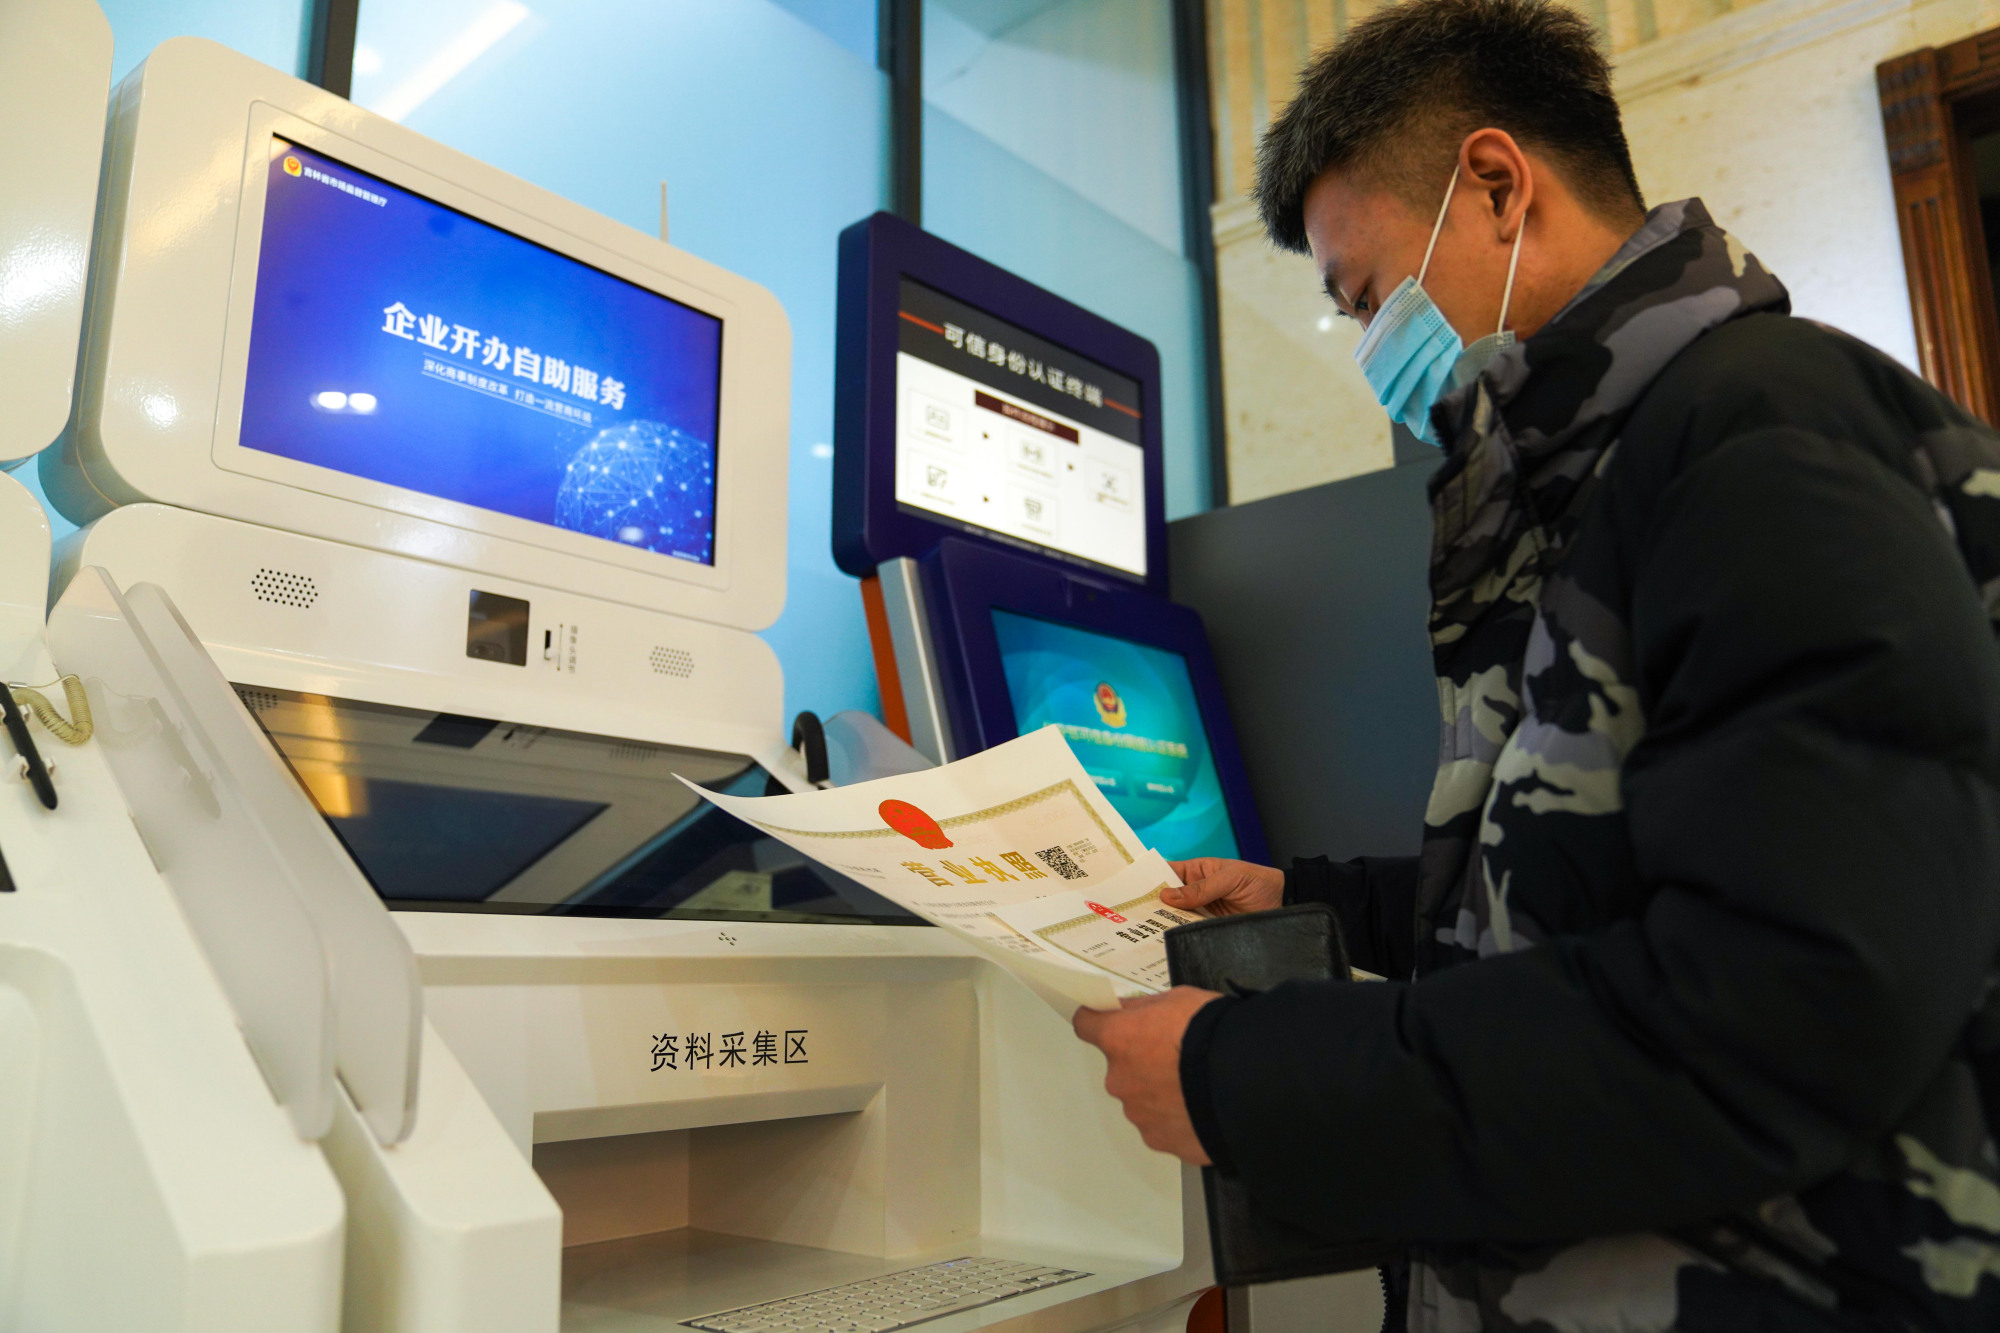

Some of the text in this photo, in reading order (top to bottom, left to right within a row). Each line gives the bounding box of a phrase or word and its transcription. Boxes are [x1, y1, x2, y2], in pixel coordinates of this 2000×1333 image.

[382, 301, 627, 411] 企业开办自助服务
[424, 358, 508, 396] 深化商事制度改革
[943, 322, 1104, 408] 可信身份认证终端
[900, 851, 1049, 888] 营业执照
[650, 1029, 809, 1073] 资料采集区
